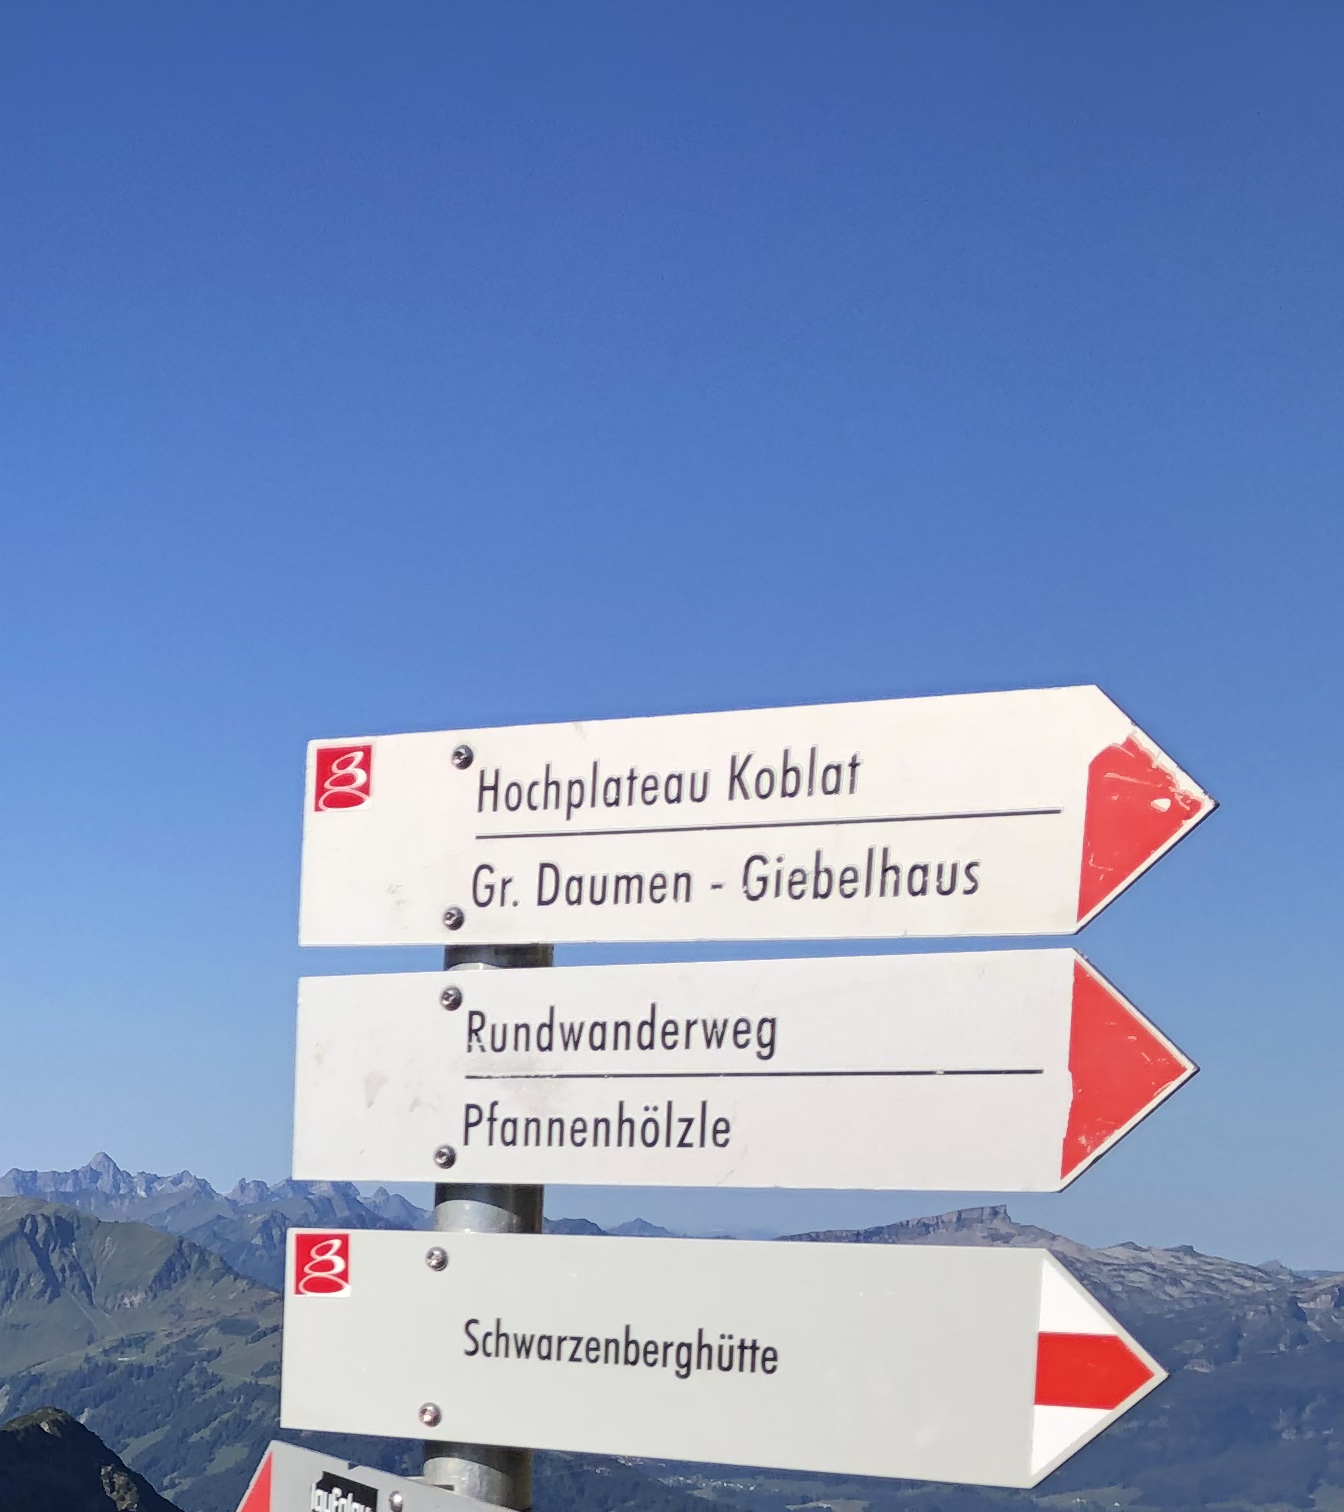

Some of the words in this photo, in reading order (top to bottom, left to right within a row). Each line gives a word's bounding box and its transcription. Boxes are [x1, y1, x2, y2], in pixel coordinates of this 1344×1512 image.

[478, 761, 708, 819] Hochplateau
[729, 747, 860, 800] Koblat
[473, 864, 518, 907] Gr.
[537, 863, 691, 906] Daumen
[743, 847, 979, 901] Giebelhaus
[468, 1003, 776, 1060] Rundwanderweg
[464, 1101, 730, 1147] Pfannenhölzle
[465, 1318, 778, 1379] Schwarzenberghütte
